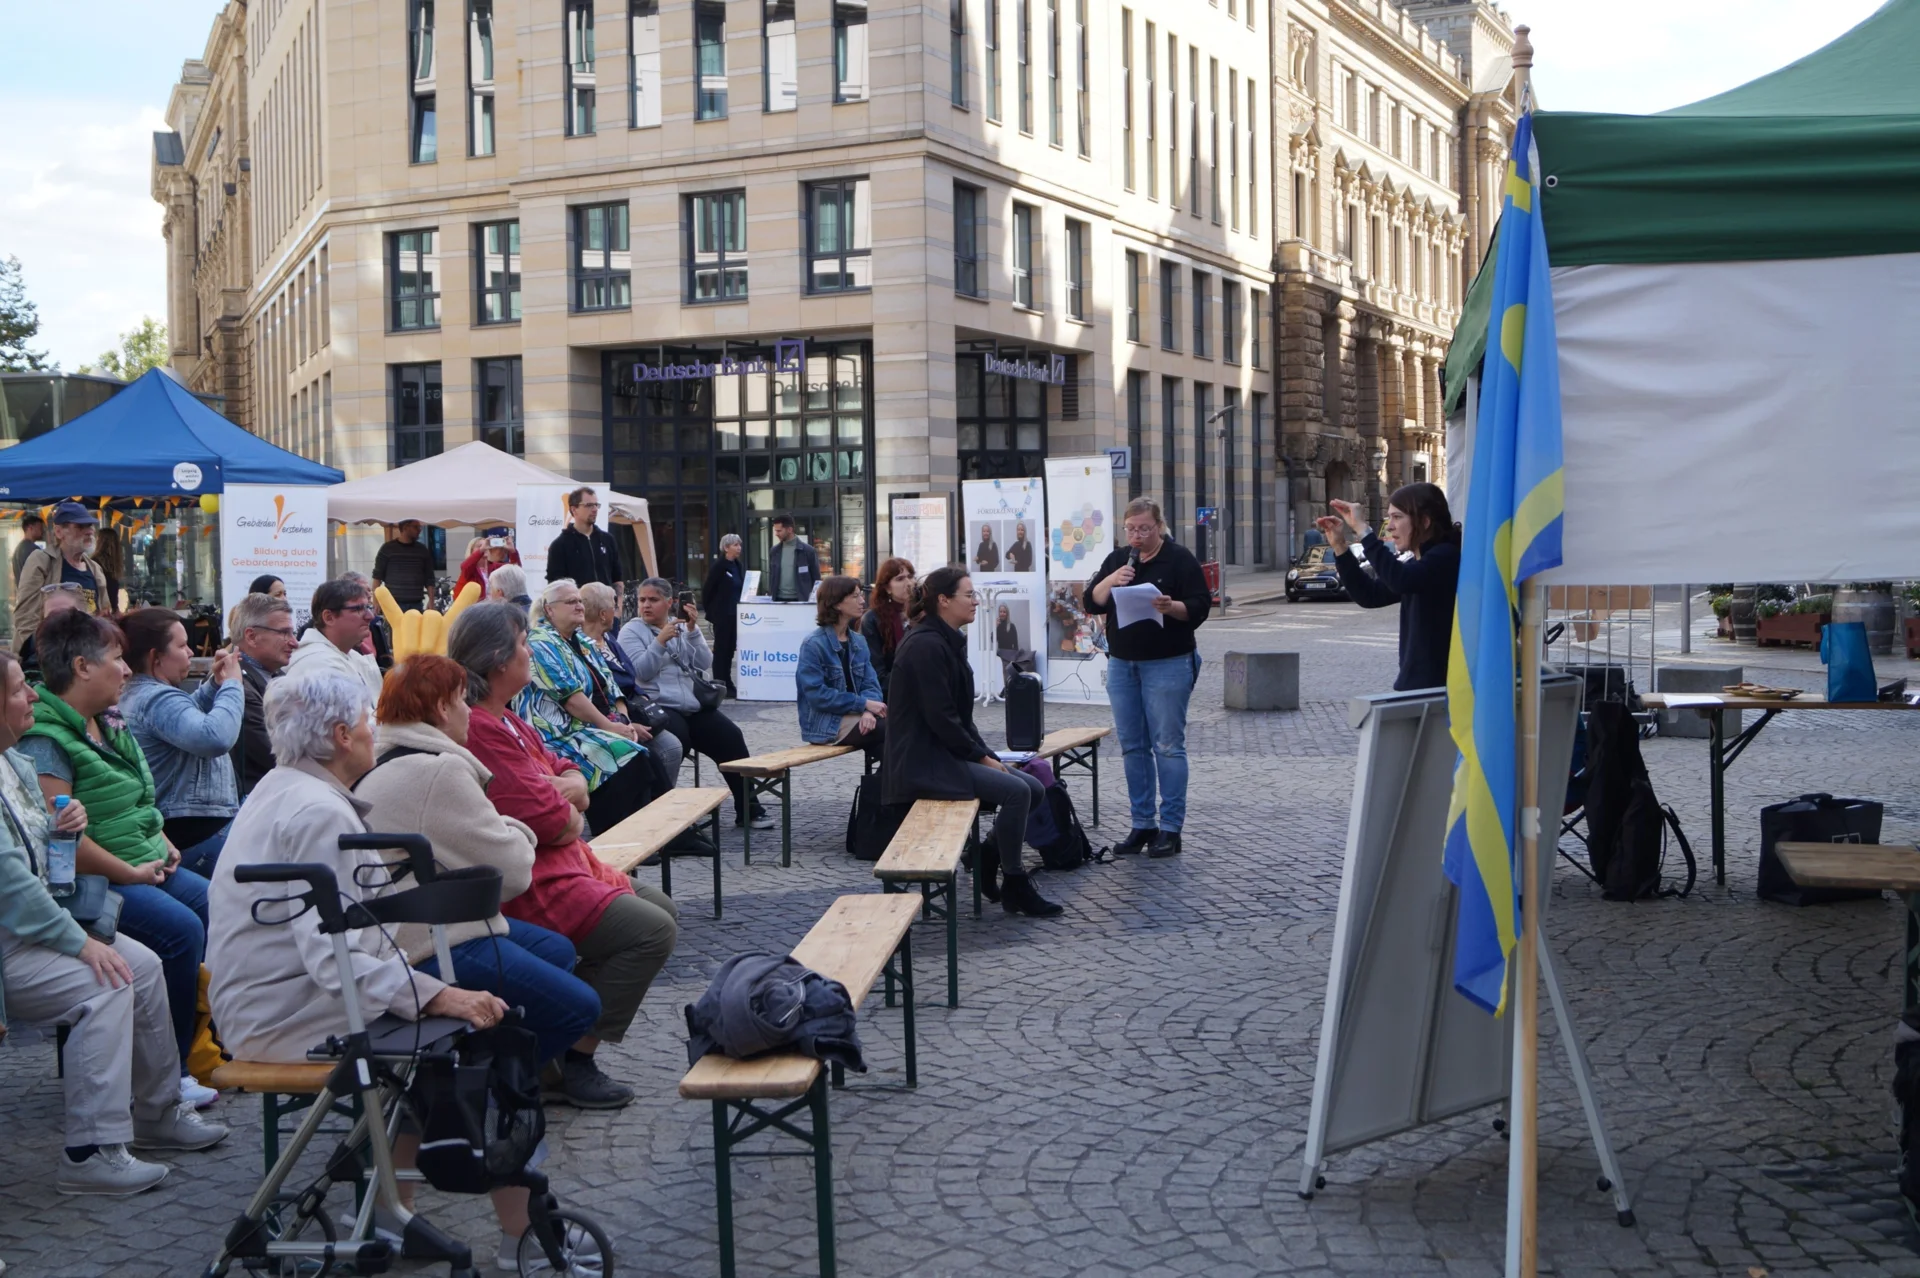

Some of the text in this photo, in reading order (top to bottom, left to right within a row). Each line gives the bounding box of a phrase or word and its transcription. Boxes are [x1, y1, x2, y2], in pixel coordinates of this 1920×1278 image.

[633, 355, 764, 382] Deutsche Bank
[985, 352, 1049, 382] Deutsche Bank
[236, 516, 277, 528] Gebärden
[528, 515, 563, 527] Gebärden
[253, 547, 318, 557] Bildung durch
[740, 650, 759, 662] Wir
[740, 665, 762, 677] Sie!
